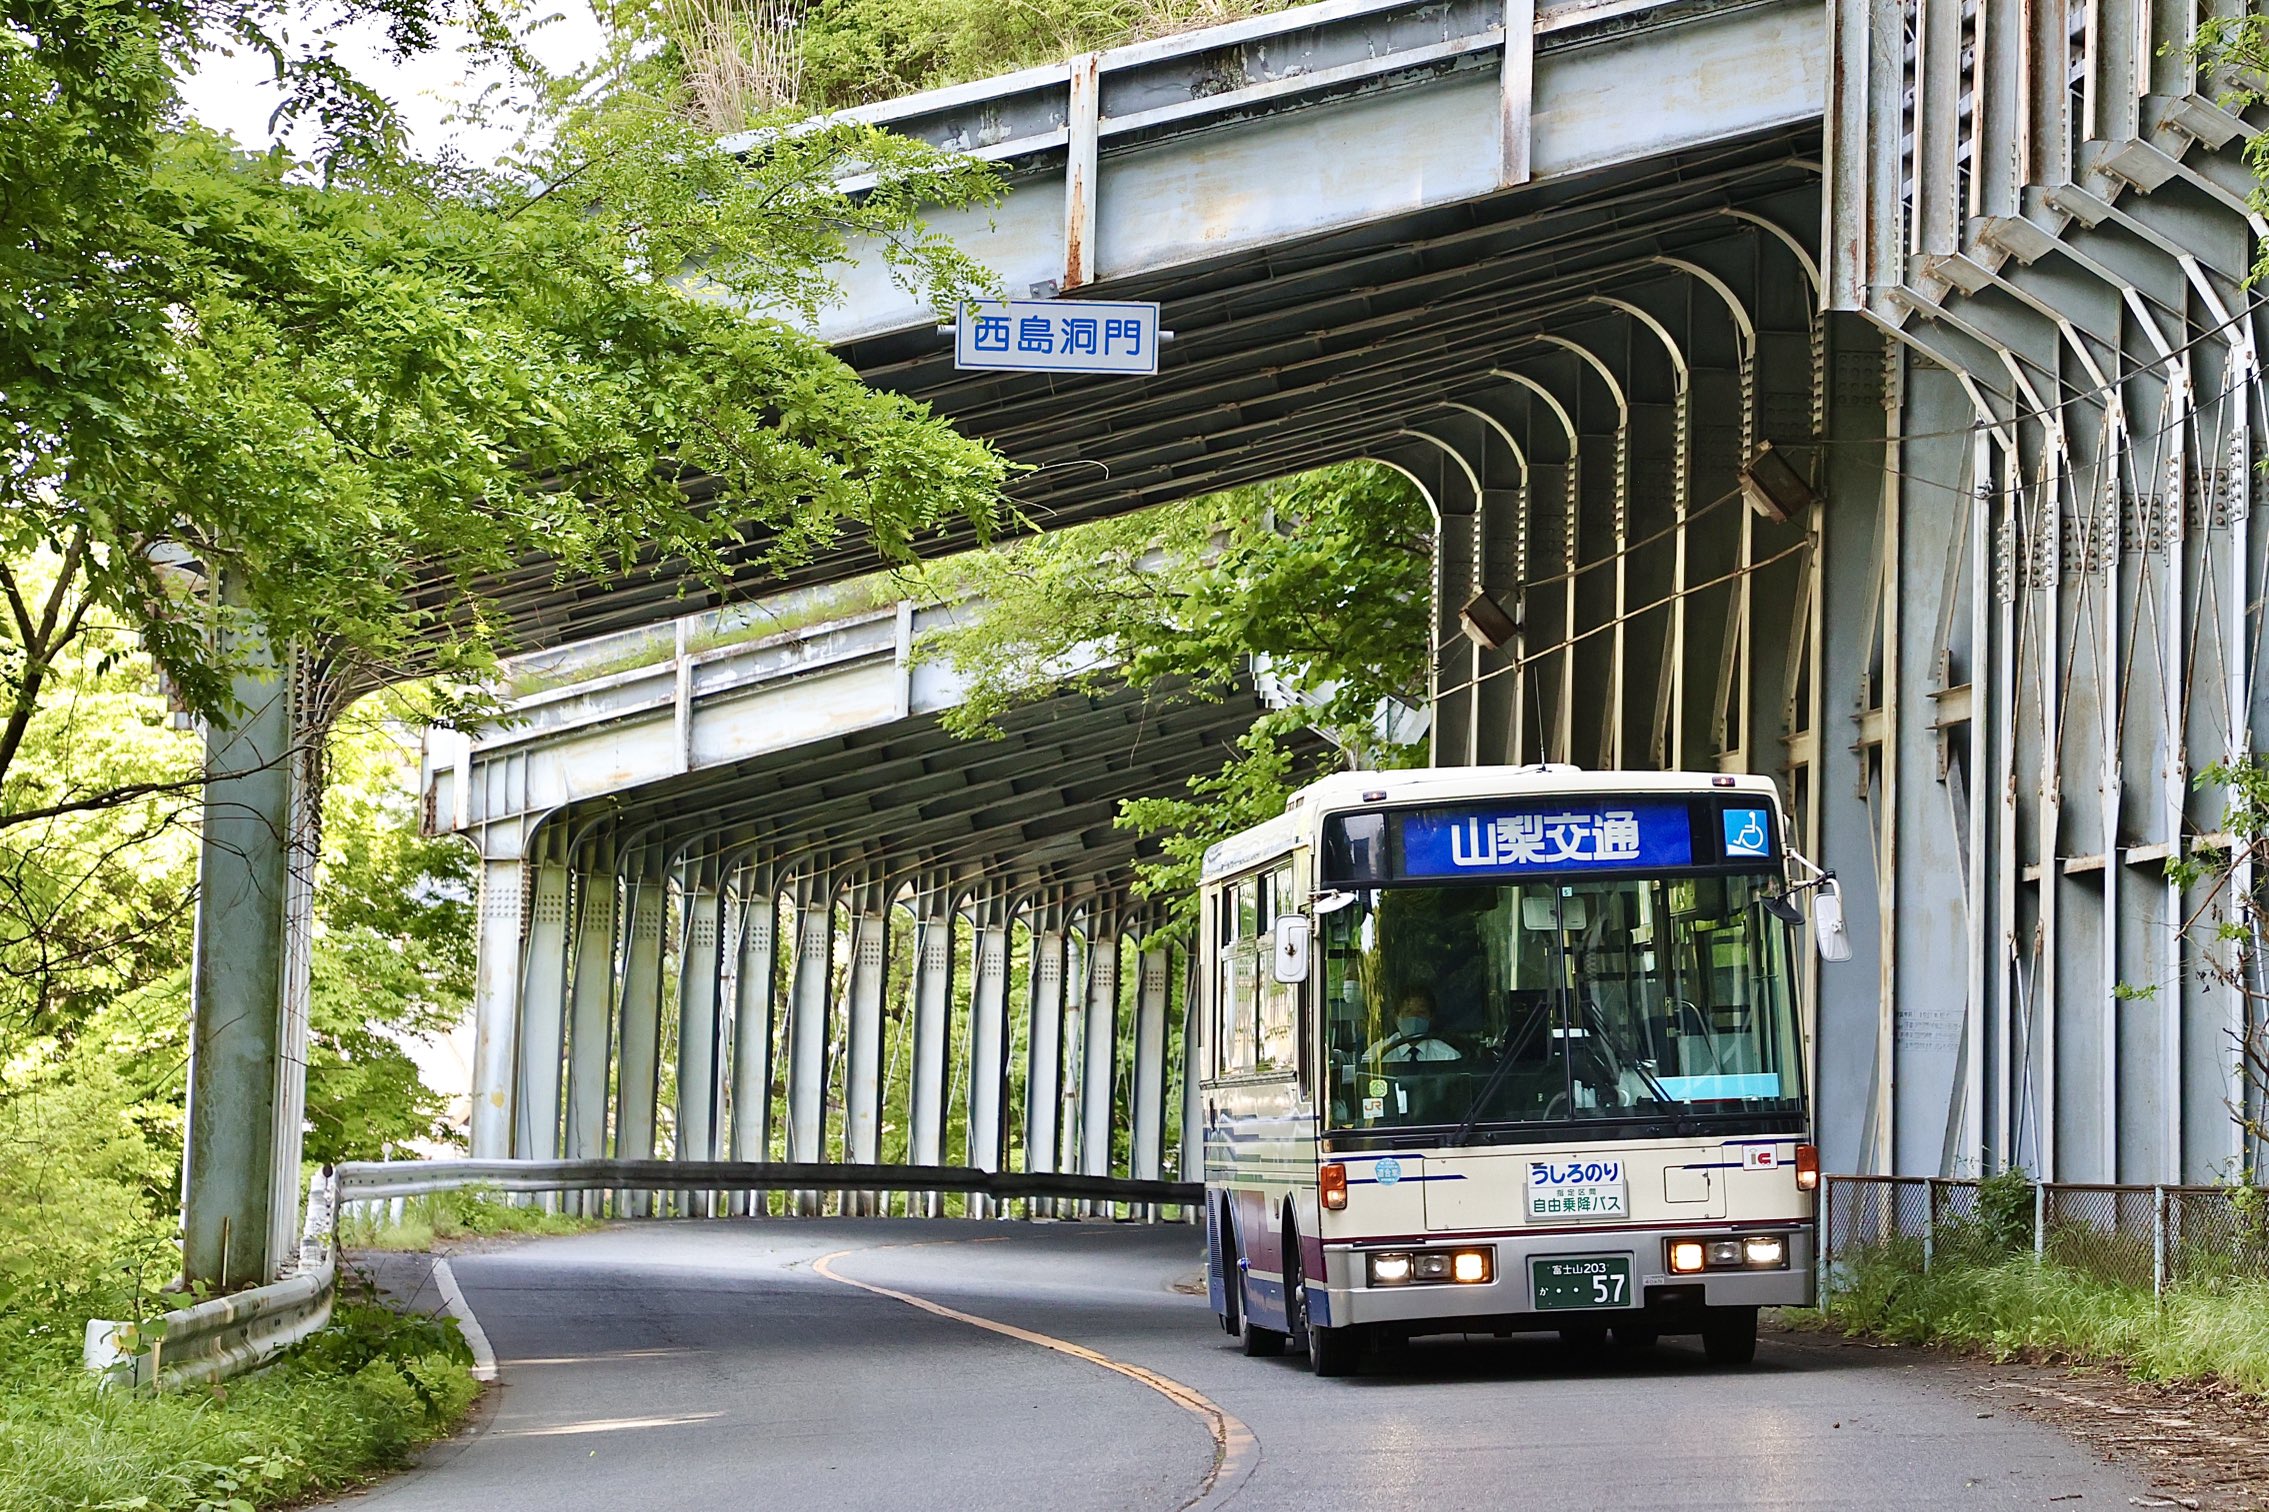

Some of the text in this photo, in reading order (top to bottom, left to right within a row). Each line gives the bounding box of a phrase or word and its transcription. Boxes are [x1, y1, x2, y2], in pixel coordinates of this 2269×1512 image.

[974, 314, 1141, 356] 西島洞門
[1451, 811, 1640, 866] 山梨交通
[1364, 1100, 1382, 1111] JR
[1531, 1162, 1618, 1185] うしろのり
[1556, 1188, 1597, 1198] 指定区間
[1533, 1196, 1621, 1213] 自由乗降バス
[1552, 1262, 1607, 1275] 富士山203
[1592, 1273, 1625, 1303] 57
